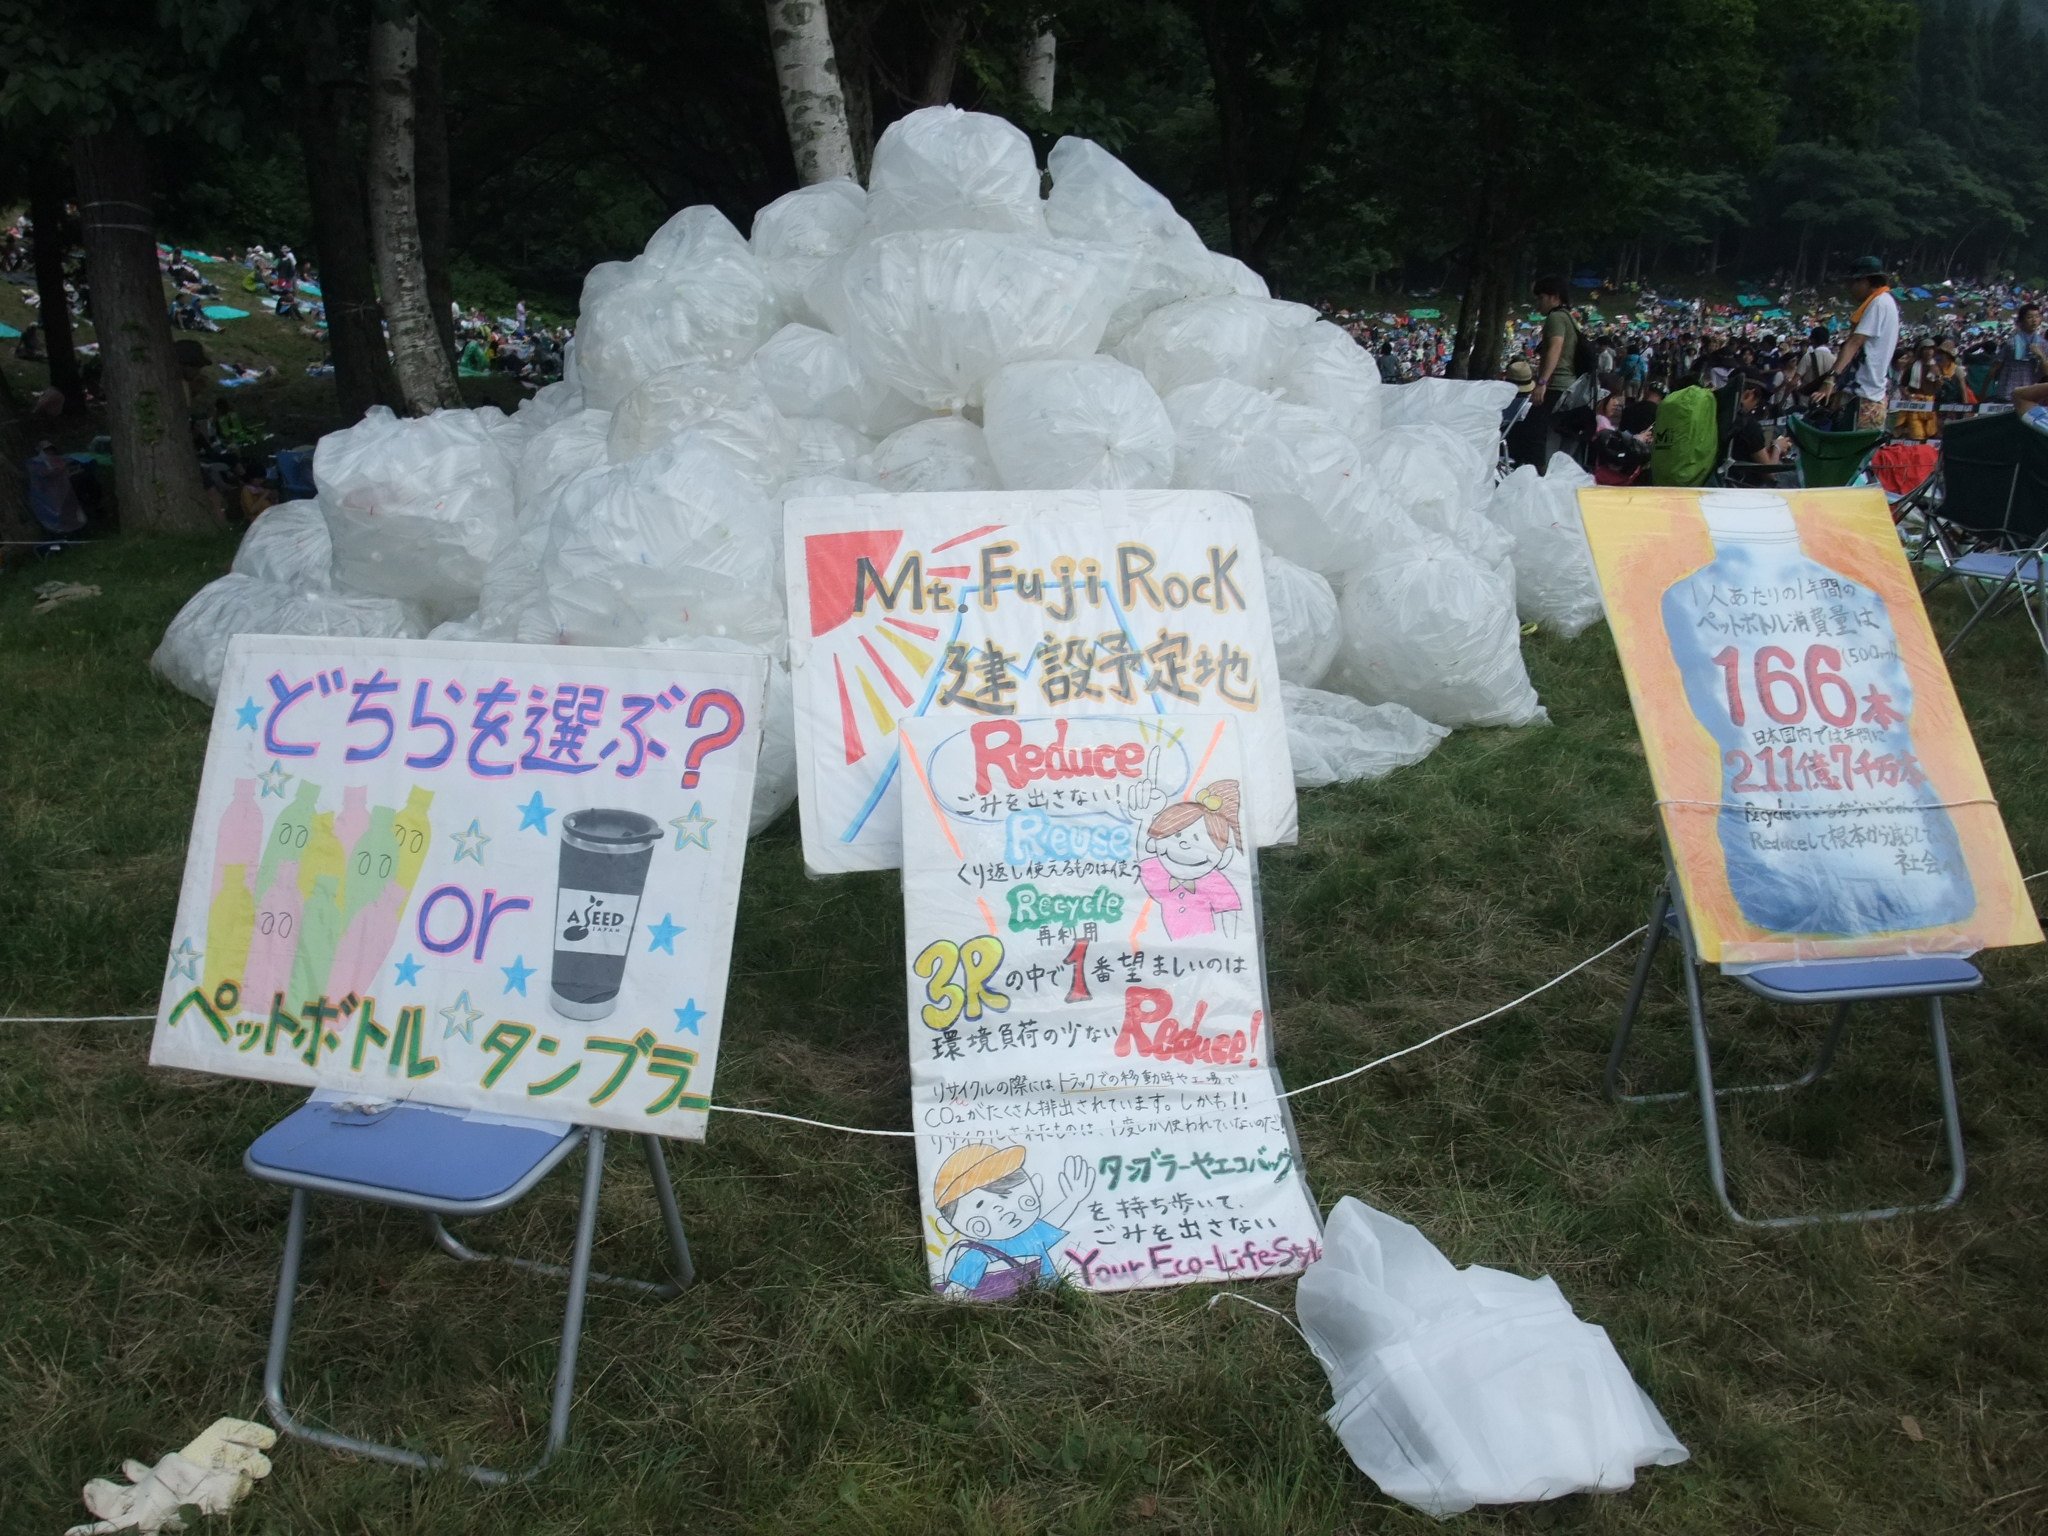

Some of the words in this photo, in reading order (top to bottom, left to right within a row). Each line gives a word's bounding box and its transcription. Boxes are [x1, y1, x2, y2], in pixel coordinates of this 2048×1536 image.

[853, 553, 969, 617] Mt.
[978, 543, 1102, 622] Fuji
[1697, 604, 1880, 637] ペットボトル消費量は
[938, 628, 1258, 714] 建設予定地
[1711, 643, 1905, 731] 166本
[263, 667, 746, 790] どちらを選ぶ?
[970, 719, 1145, 796] Reduce
[956, 784, 1122, 817] ごみを出さない!
[1006, 810, 1133, 864] Reuse
[1894, 848, 1942, 876] 社会
[416, 882, 533, 964] or
[1010, 886, 1124, 930] Recycle
[1036, 923, 1098, 946] 再利用
[168, 978, 440, 1079] ペットボトル
[480, 1020, 711, 1116] タンブラー
[1093, 1217, 1277, 1246] ごみを出さない
[1064, 1246, 1146, 1287] Your
